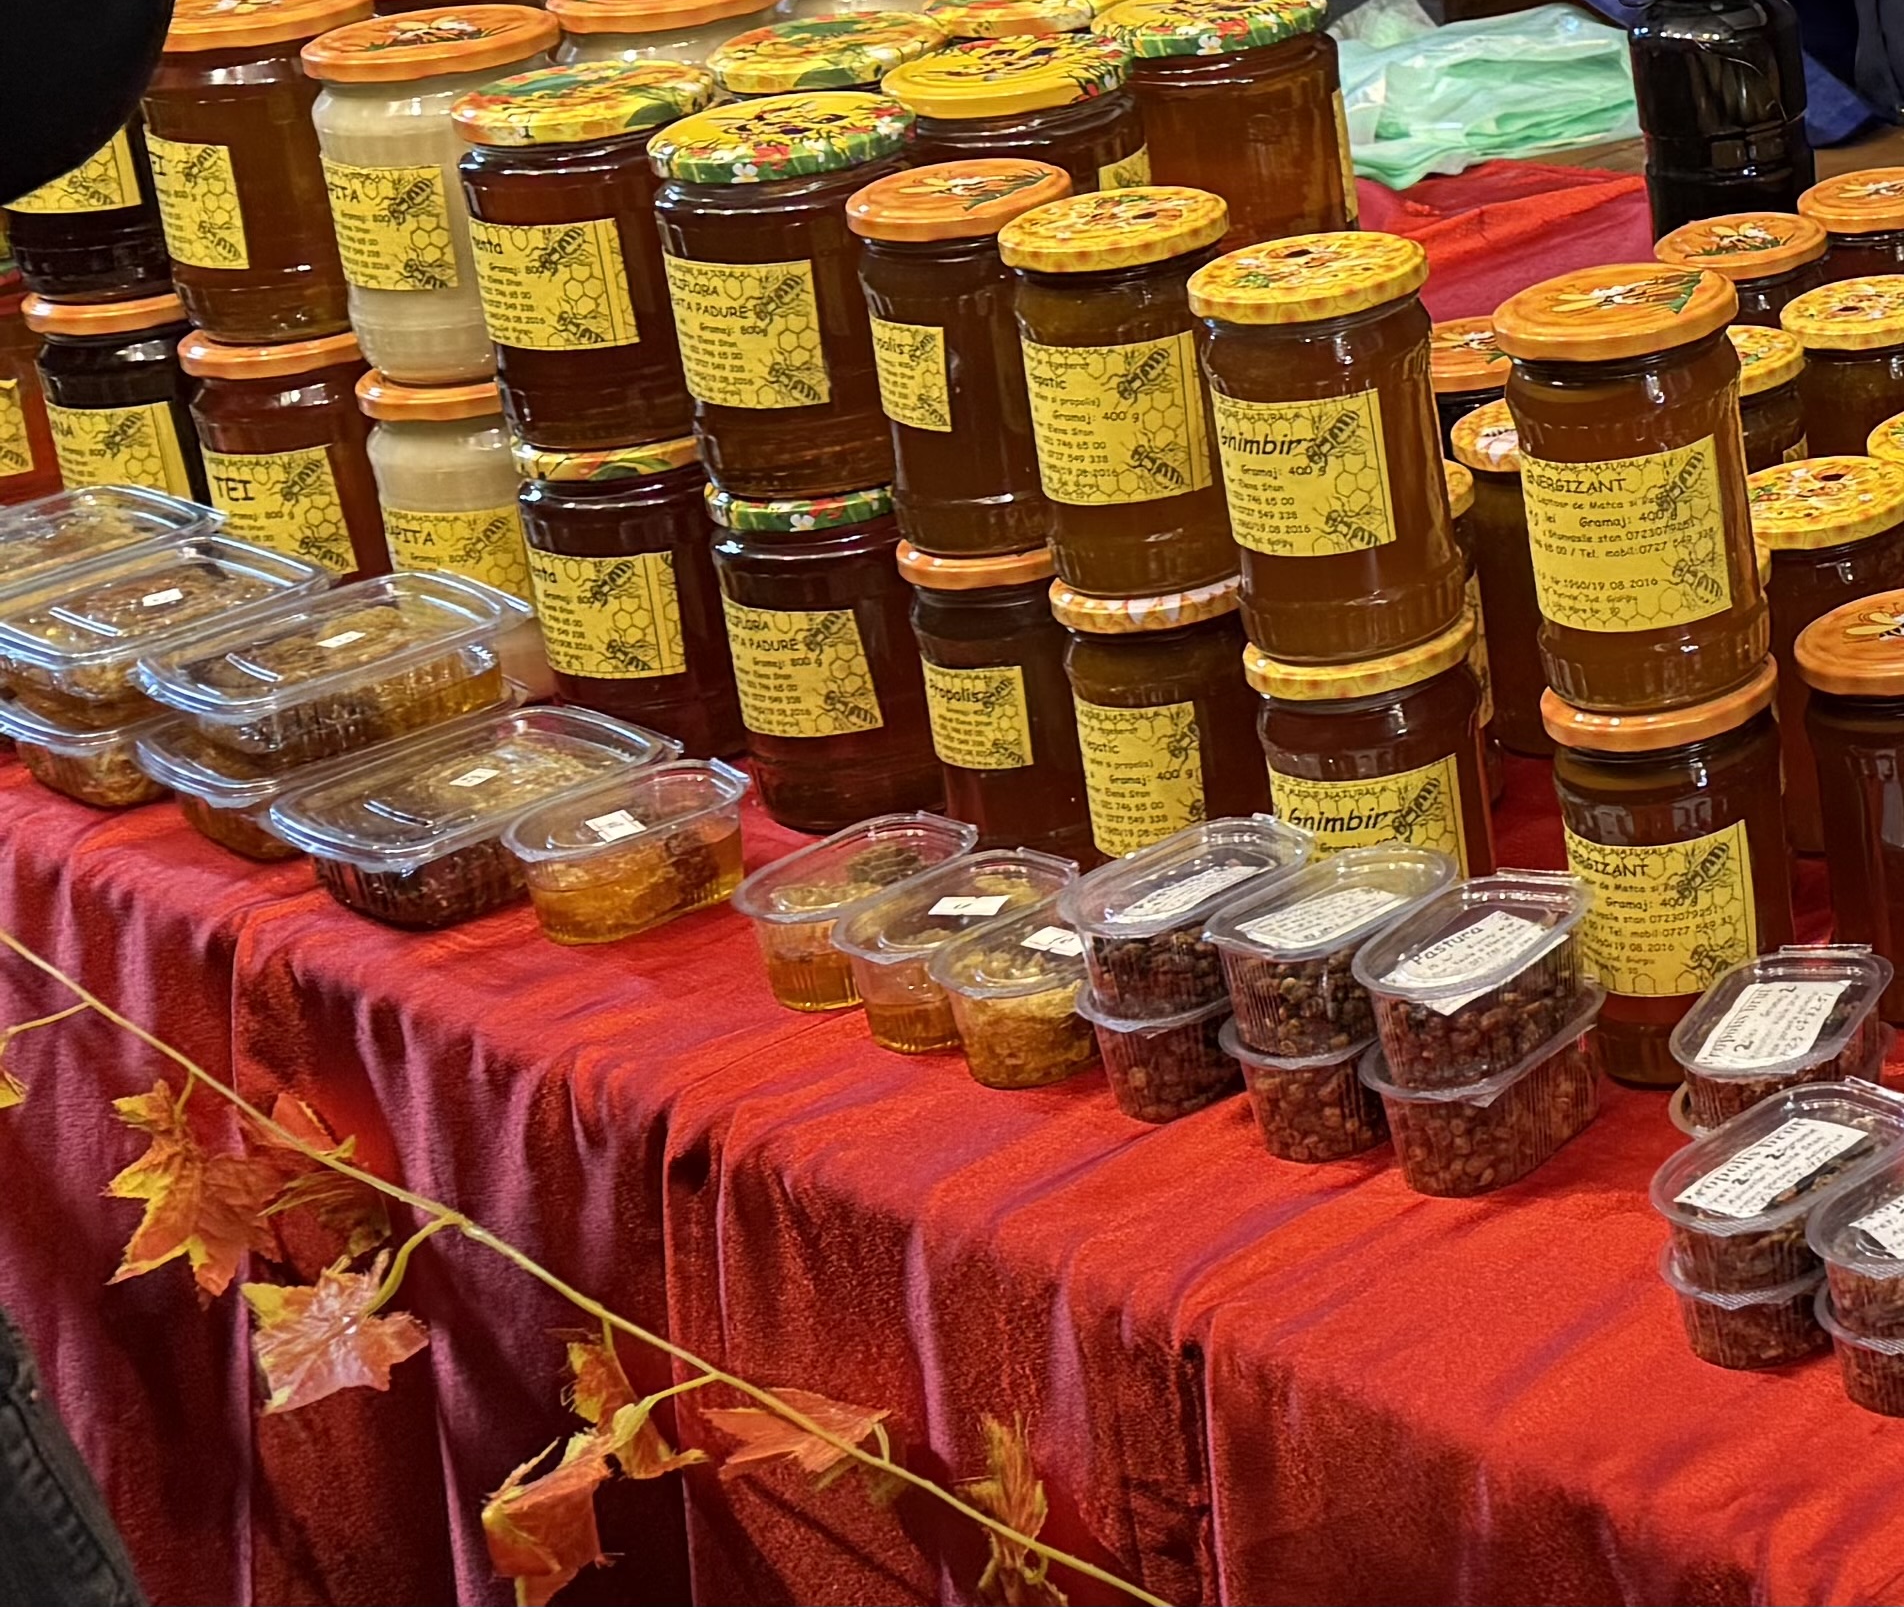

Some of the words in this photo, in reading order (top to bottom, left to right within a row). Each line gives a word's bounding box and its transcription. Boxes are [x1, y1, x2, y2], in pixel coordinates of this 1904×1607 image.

[696, 301, 749, 320] PADURE
[1102, 410, 1126, 422] 400
[1288, 465, 1313, 476] 400
[213, 475, 255, 502] TEI
[1579, 515, 1632, 529] Gramaj:
[1638, 509, 1663, 522] 400
[750, 637, 801, 652] PADURE
[1156, 769, 1180, 781] 400
[1605, 896, 1653, 912] Gramaj:
[1660, 896, 1684, 907] 400
[1413, 925, 1484, 965] Pastura
